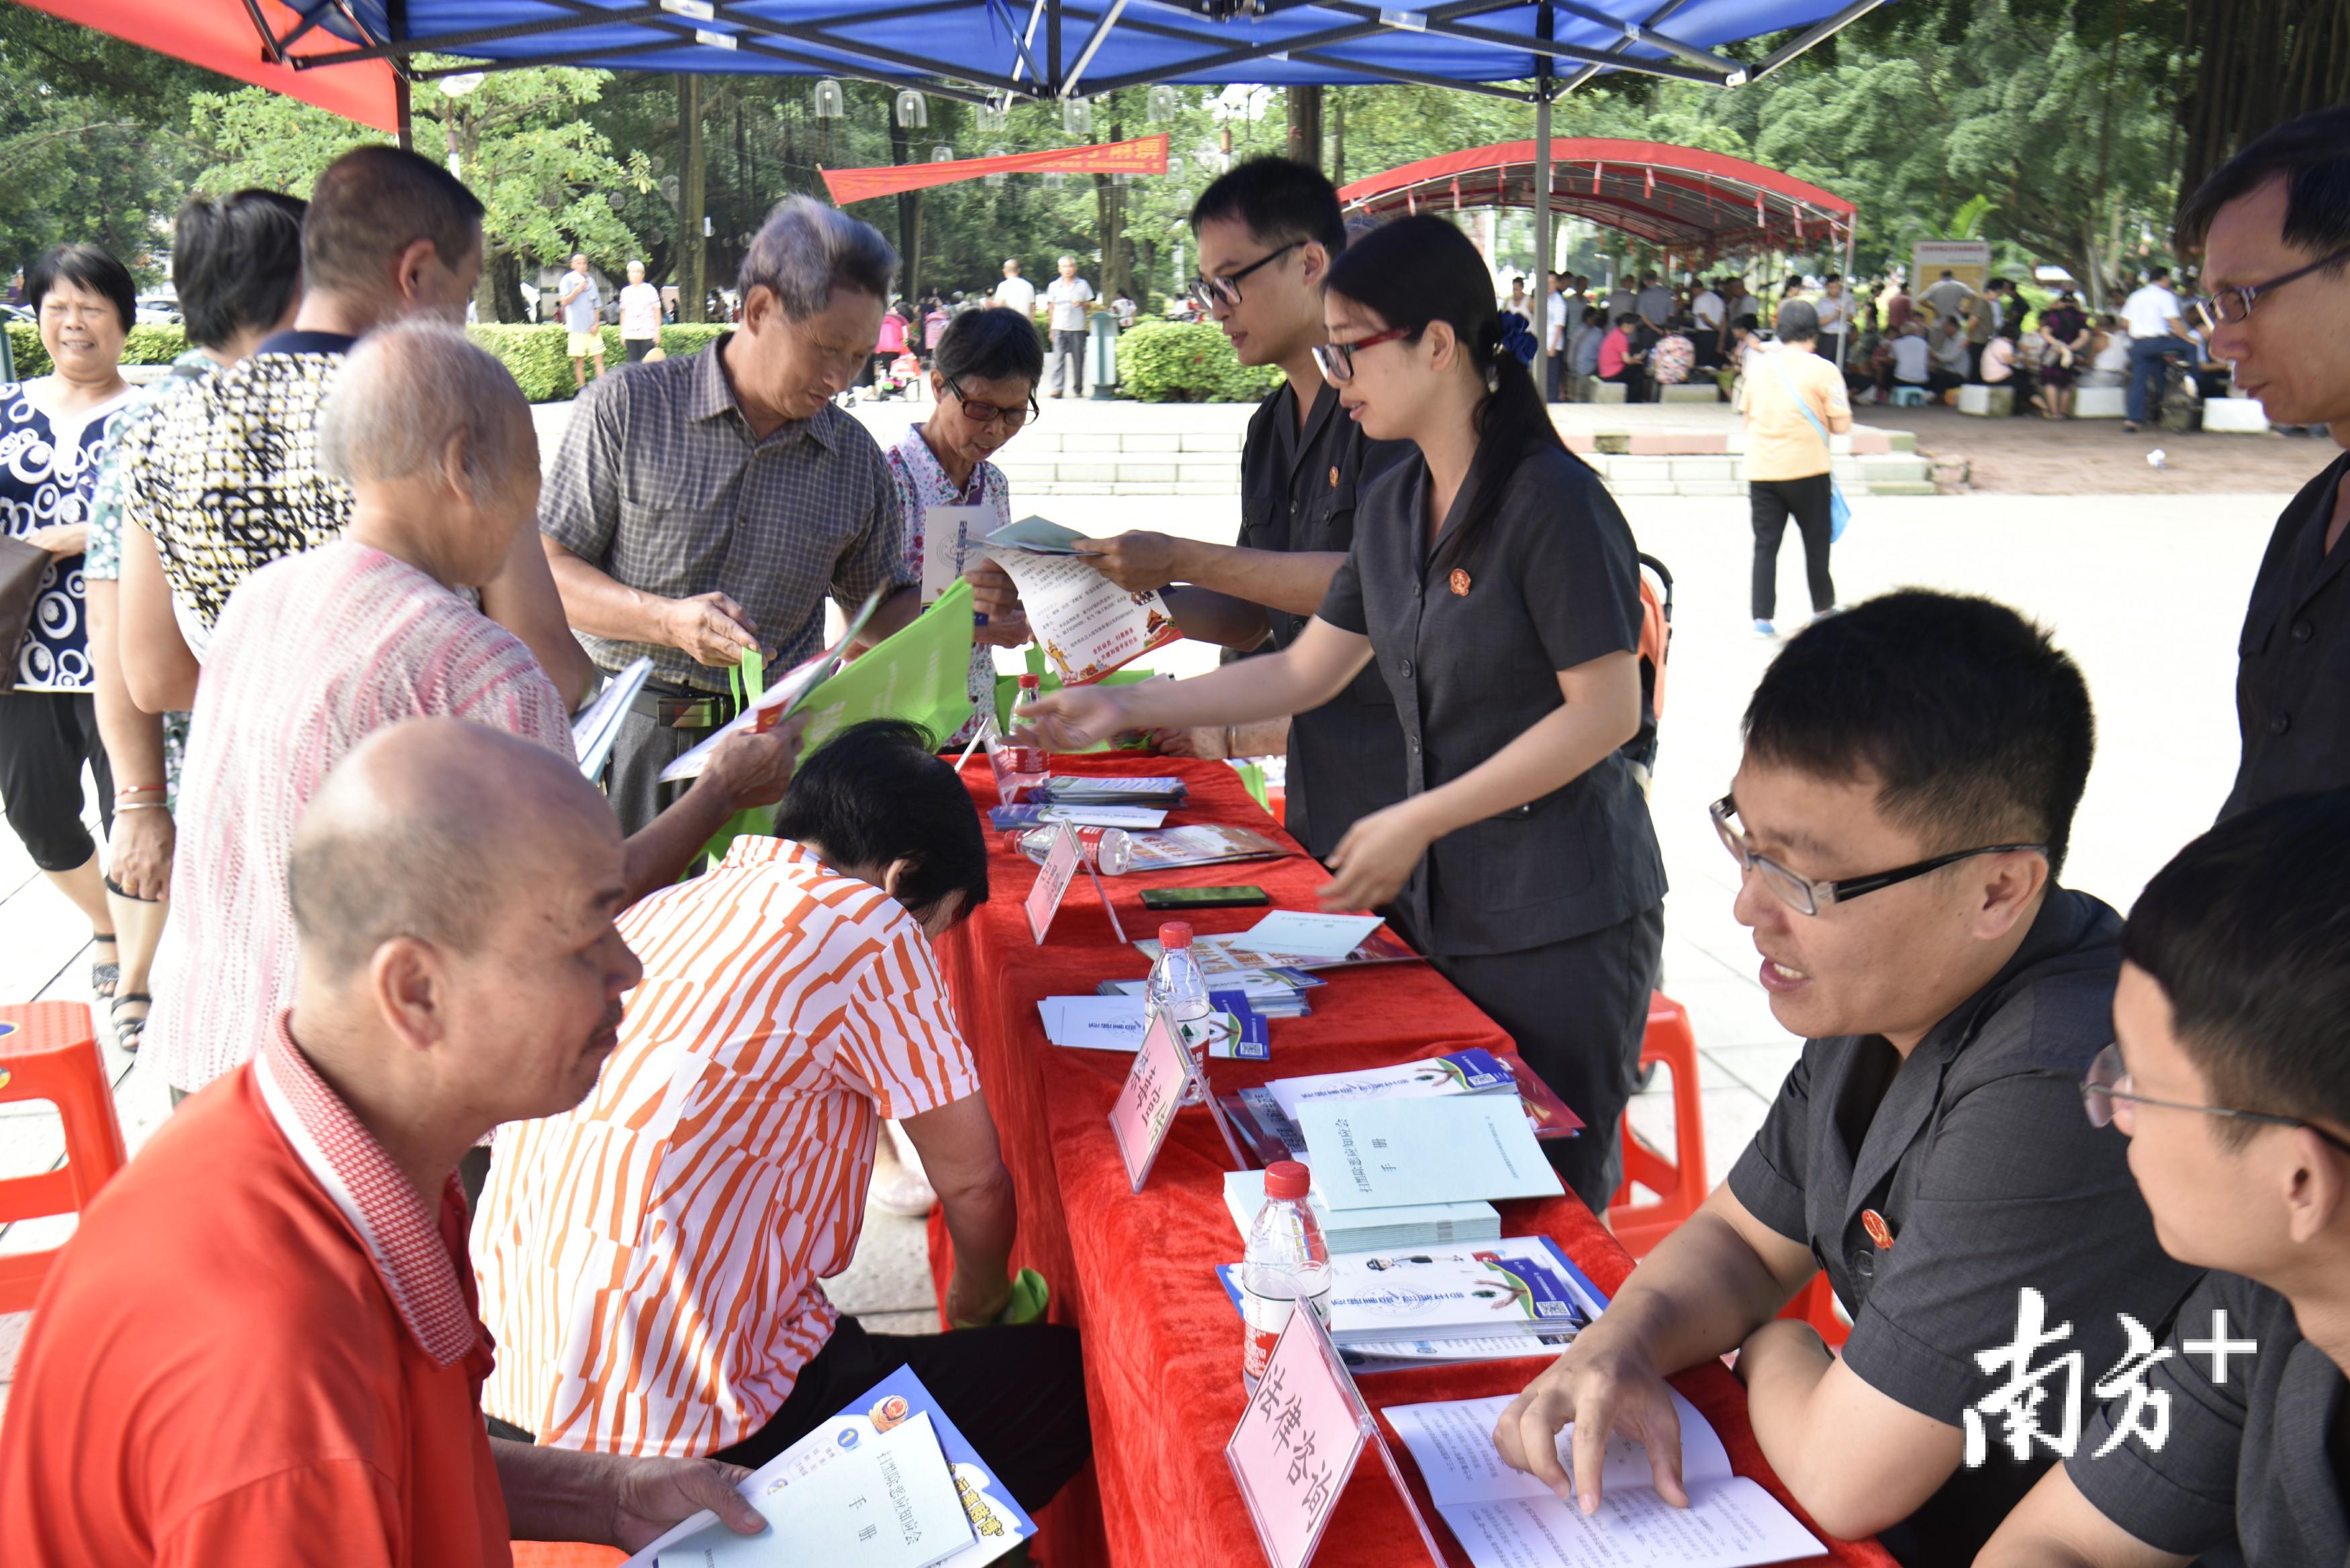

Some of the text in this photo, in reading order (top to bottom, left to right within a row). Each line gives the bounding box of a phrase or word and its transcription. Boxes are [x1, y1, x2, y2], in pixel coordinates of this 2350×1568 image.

[1130, 1047, 1168, 1145] 禁毒宣传
[1335, 1118, 1372, 1192] 扫黑除恶应知应会
[841, 1430, 855, 1444] 1
[1258, 1363, 1332, 1533] 法律咨询
[877, 1450, 922, 1545] 扫黑除恶应知应会
[947, 1460, 1005, 1536] 远离赌博”
